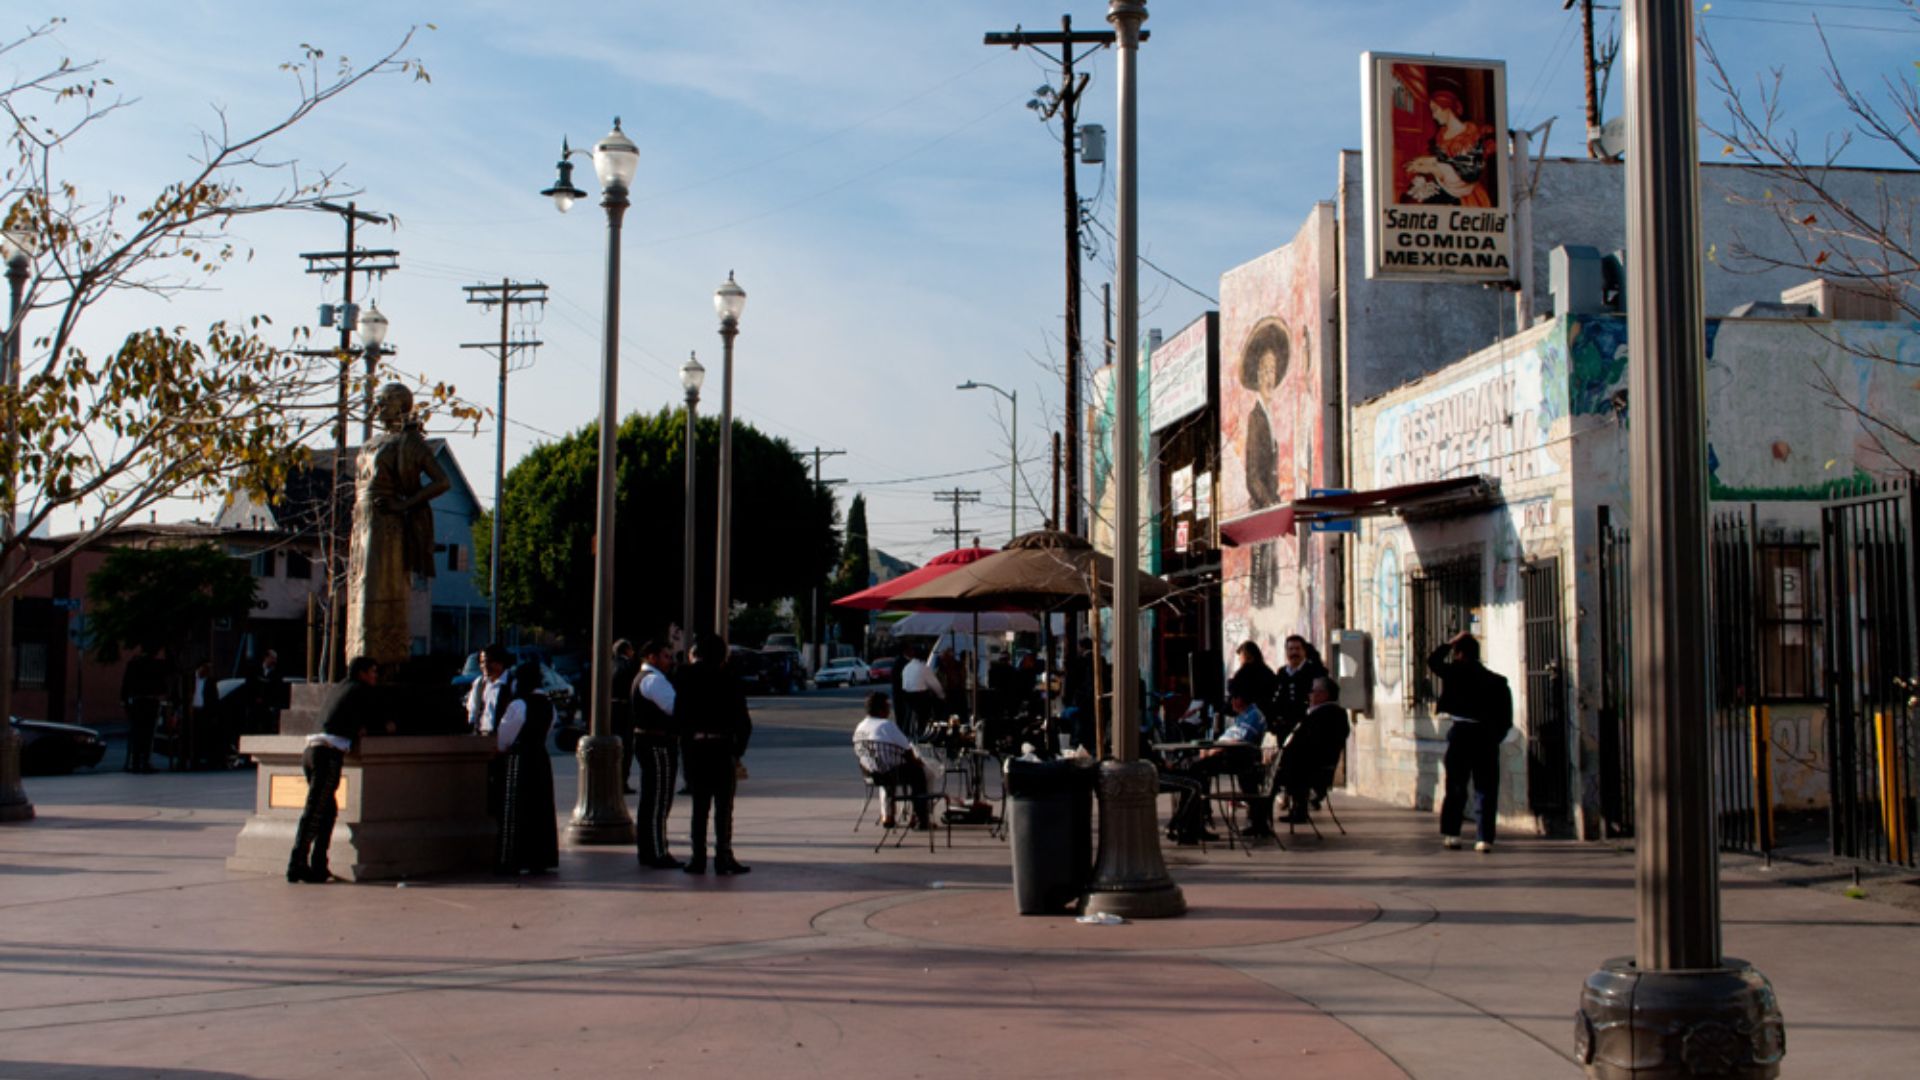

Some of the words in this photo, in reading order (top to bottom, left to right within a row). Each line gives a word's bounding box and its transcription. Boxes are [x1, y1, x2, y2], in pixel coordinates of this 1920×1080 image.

[1398, 233, 1496, 250] COMIDA
[1385, 250, 1509, 268] MEXICANA
[1400, 371, 1516, 449] RESTAURANT
